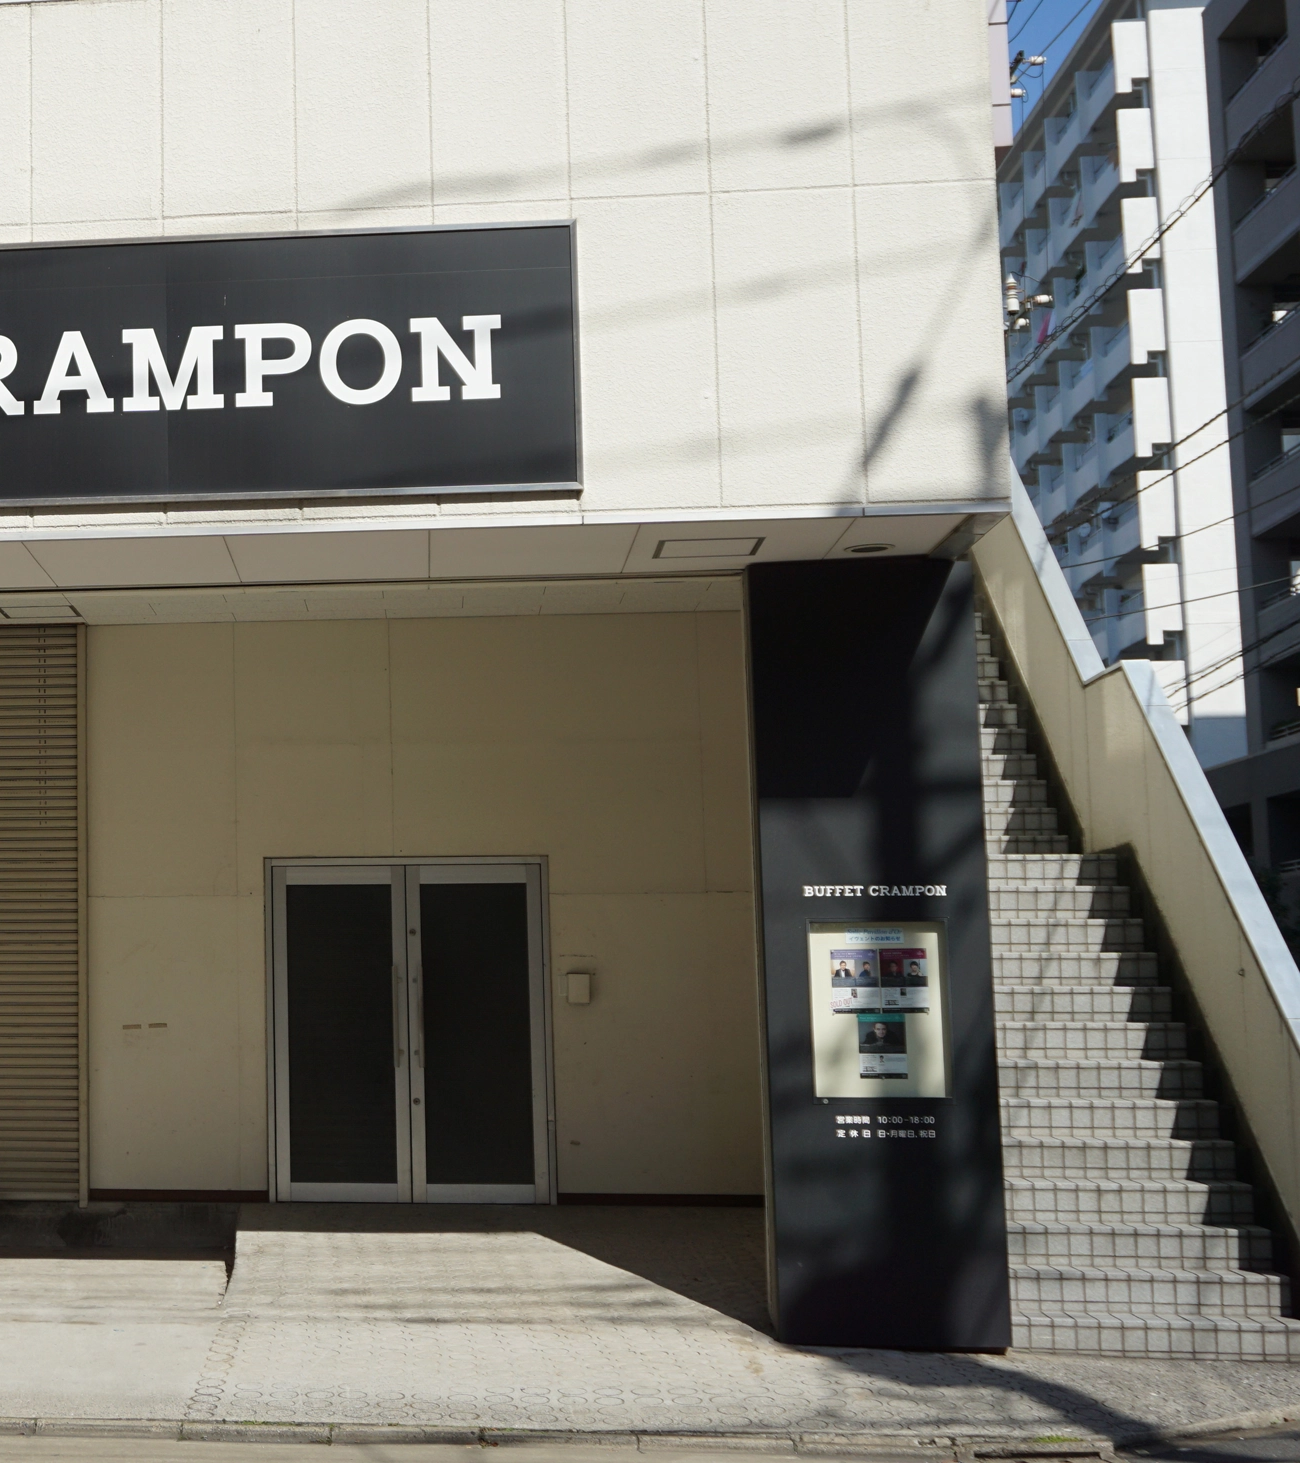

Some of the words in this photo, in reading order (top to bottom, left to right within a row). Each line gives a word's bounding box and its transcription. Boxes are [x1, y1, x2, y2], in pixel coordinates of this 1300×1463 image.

[803, 885, 864, 897] BUFFET
[868, 885, 947, 896] CRAMPON
[830, 1000, 843, 1009] SOLD
[843, 997, 853, 1006] OUT
[835, 1115, 871, 1125] 営業時間
